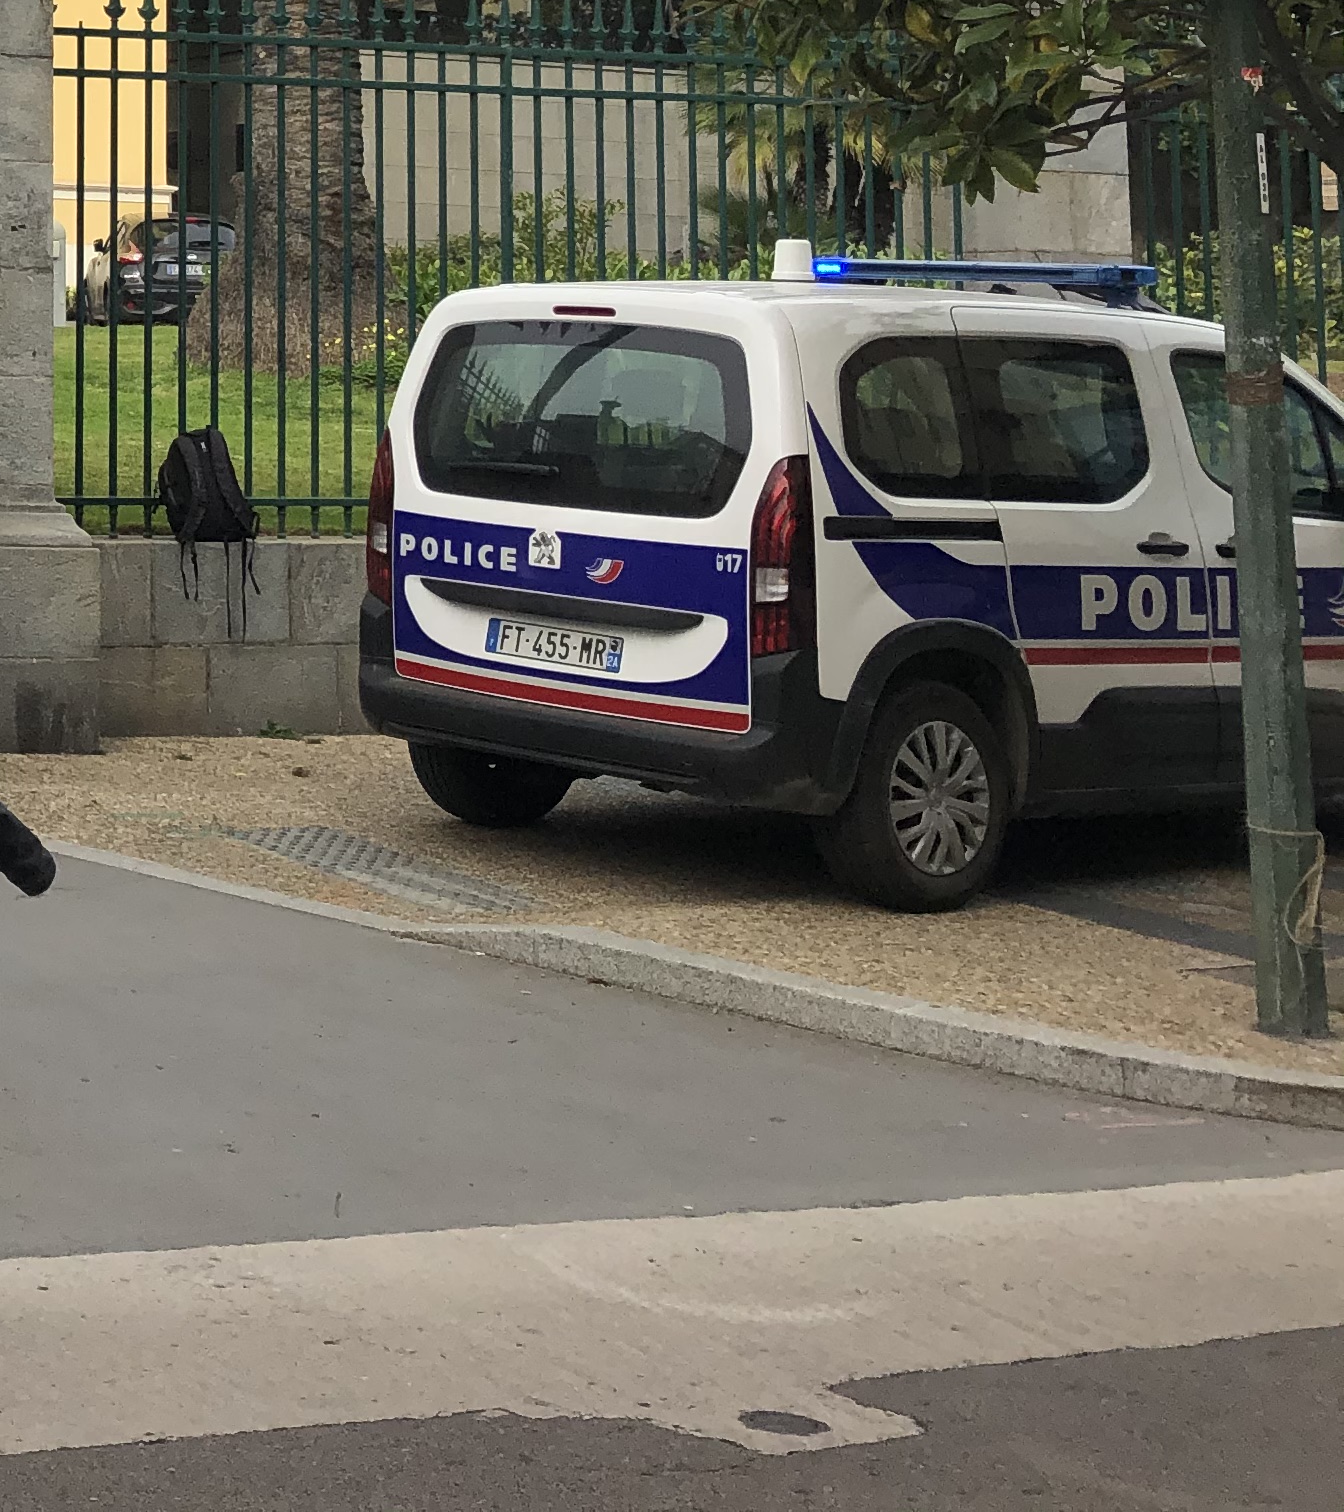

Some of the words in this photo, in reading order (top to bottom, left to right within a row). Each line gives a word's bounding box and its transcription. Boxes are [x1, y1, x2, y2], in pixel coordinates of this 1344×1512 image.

[399, 532, 517, 572] POLICE
[1080, 573, 1306, 632] POLI
[606, 655, 619, 668] 2A
